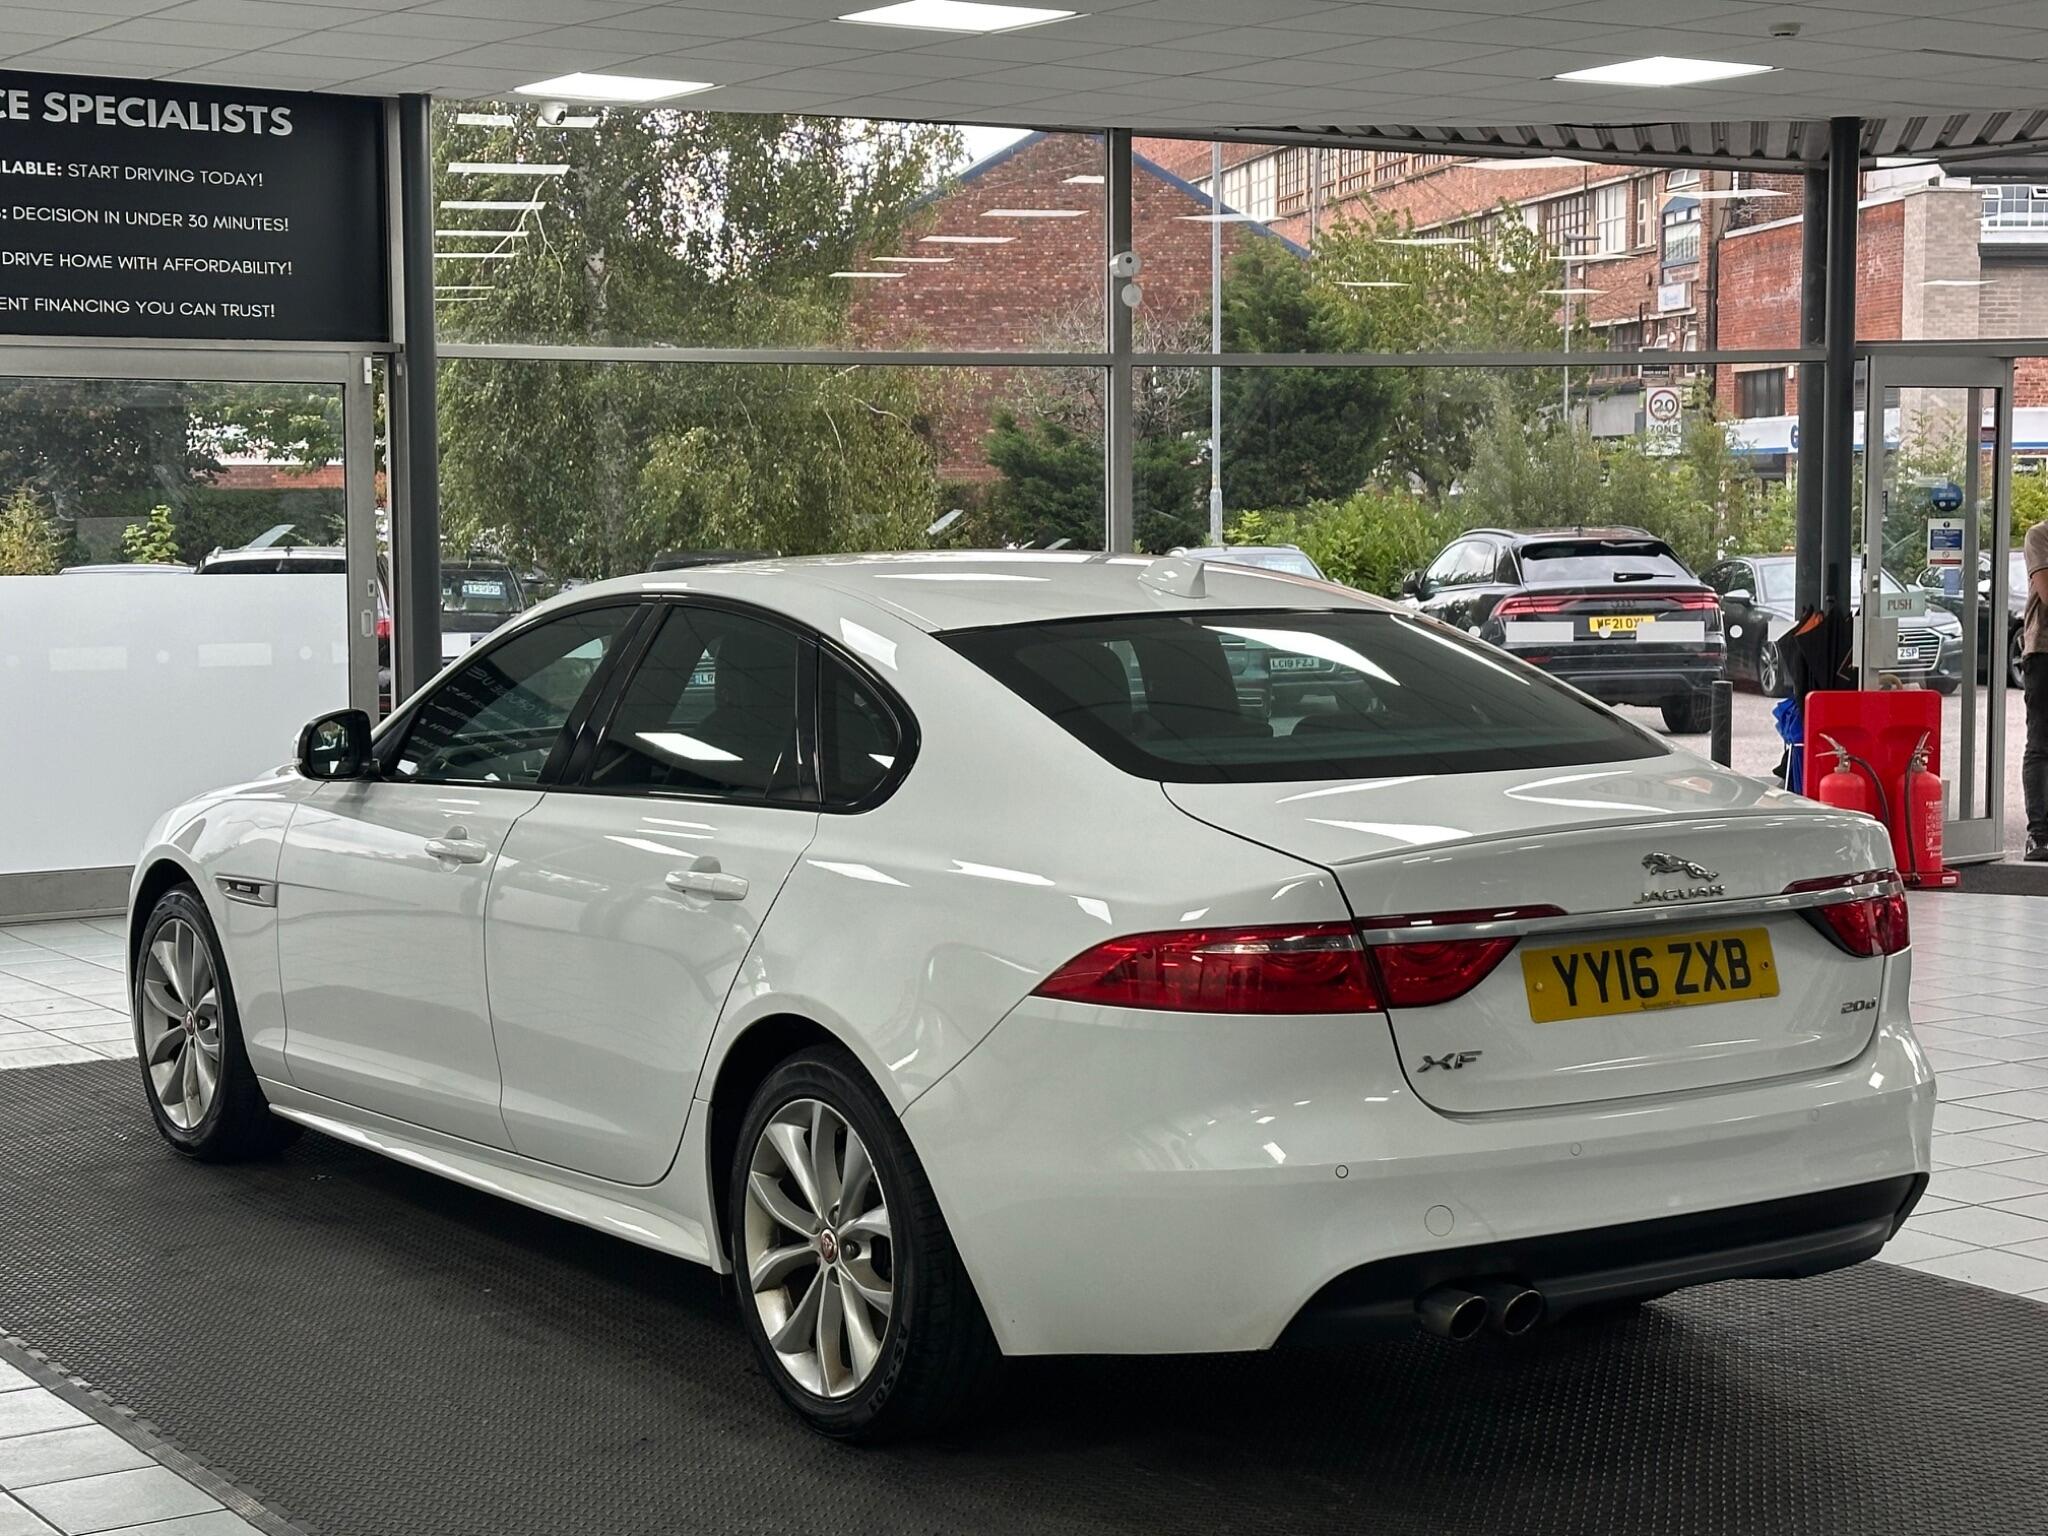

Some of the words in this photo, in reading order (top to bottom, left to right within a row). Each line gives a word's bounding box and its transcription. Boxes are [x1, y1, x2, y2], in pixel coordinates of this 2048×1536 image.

[0, 89, 30, 121] E
[42, 91, 294, 136] SPECIALISTS
[67, 162, 120, 180] START
[124, 166, 196, 184] DRIVING
[200, 170, 264, 188] TODAY!
[12, 205, 99, 225] DECISION
[104, 210, 121, 225] IN
[125, 211, 183, 228] UNDER
[188, 213, 209, 229] 30
[212, 215, 290, 232] MINUTES!
[1, 251, 54, 268] DRIVE
[59, 253, 114, 270] HOME
[117, 256, 159, 271] WITH
[162, 257, 294, 276] AFFORDABILITY!
[34, 297, 131, 315] FINANCING
[134, 299, 176, 316] YOU
[179, 301, 217, 317] CAN
[221, 303, 276, 318] TRUST!
[1654, 399, 1675, 413] 20
[1887, 598, 1912, 611] PUSH
[1626, 618, 1644, 630] OX
[1899, 647, 1918, 658] ZSP
[1633, 884, 1736, 905] JAGUAR
[1551, 946, 1660, 1007] YY16
[1667, 938, 1752, 995] ZXB
[1841, 996, 1877, 1015] 20d
[1416, 1050, 1484, 1074] XF
